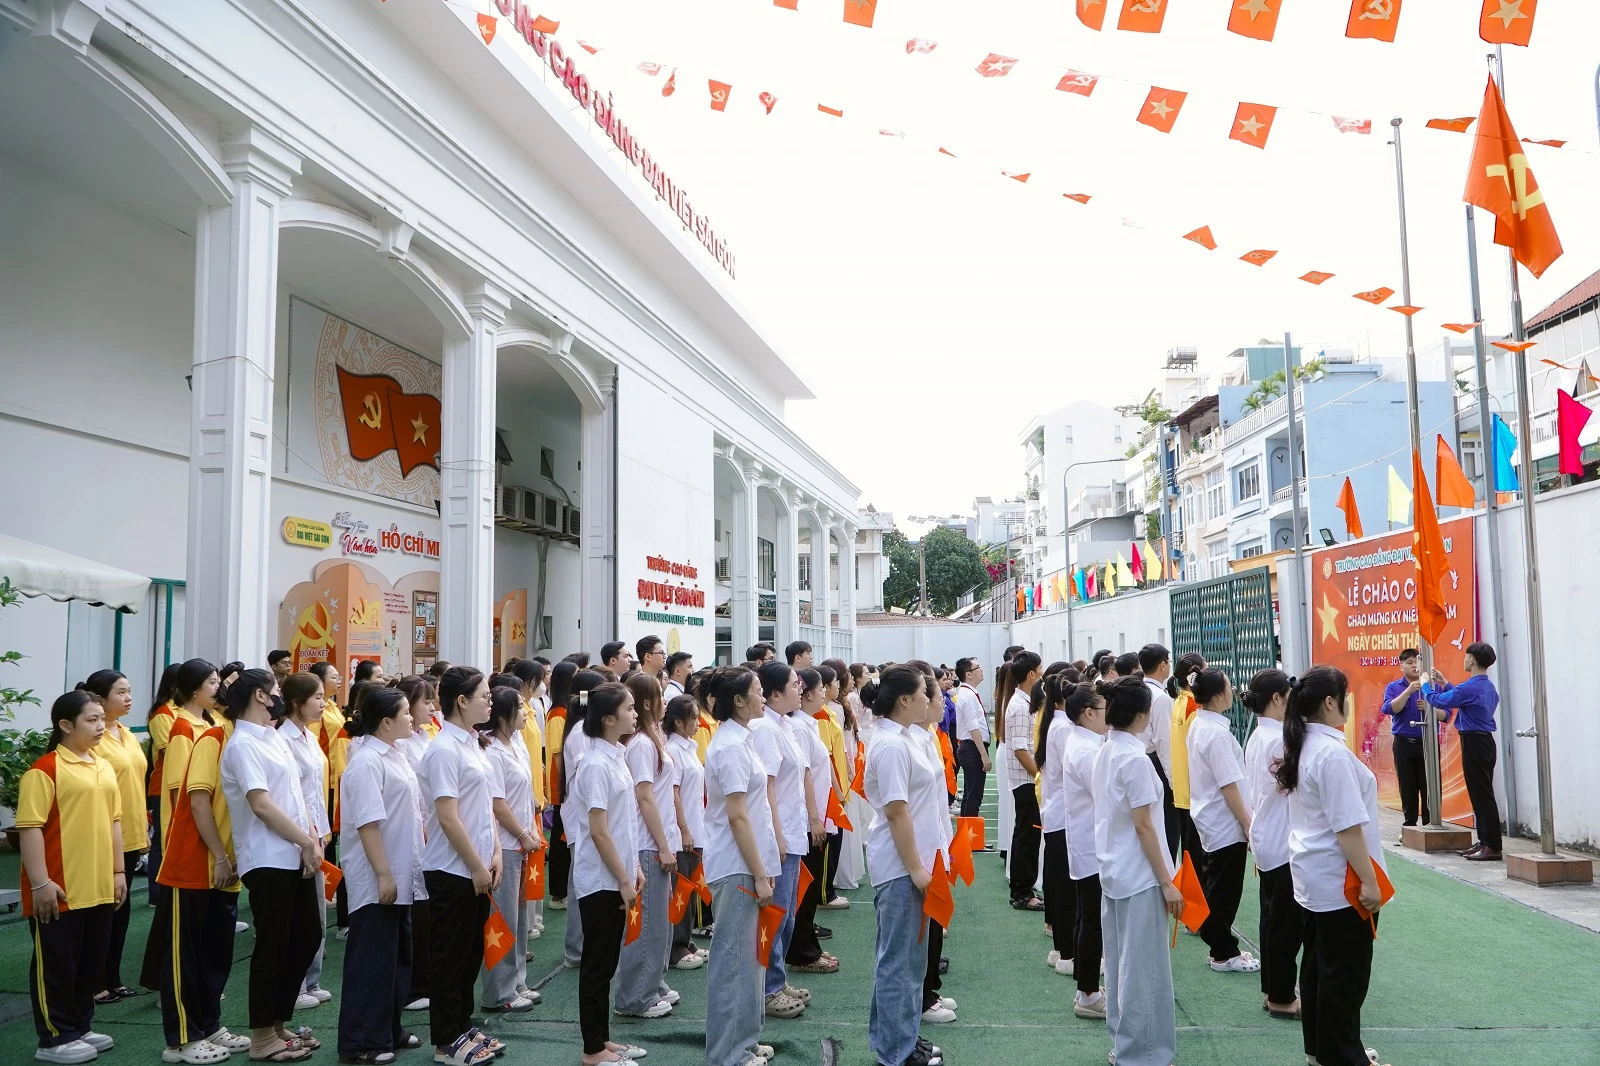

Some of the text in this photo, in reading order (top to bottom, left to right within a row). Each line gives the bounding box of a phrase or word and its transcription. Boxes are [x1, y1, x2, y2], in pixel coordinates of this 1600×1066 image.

[549, 40, 592, 110] CAO
[593, 90, 641, 166] ĐẲNG
[640, 148, 666, 202] ĐẠI
[666, 178, 696, 233] VIỆT
[343, 533, 364, 554] Văn
[1335, 555, 1360, 574] TRƯỜNG
[1359, 554, 1373, 570] CAO
[1391, 547, 1405, 566] ĐẠI
[654, 579, 675, 611] VIỆT
[1348, 575, 1418, 607] LỄ CHÀO C
[1347, 611, 1367, 628] CHÀO
[1402, 605, 1419, 626] NIỆ
[1347, 631, 1371, 652] NGÀY
[1371, 628, 1400, 651] CHIẾN
[1361, 656, 1388, 667] 30/4/1975
